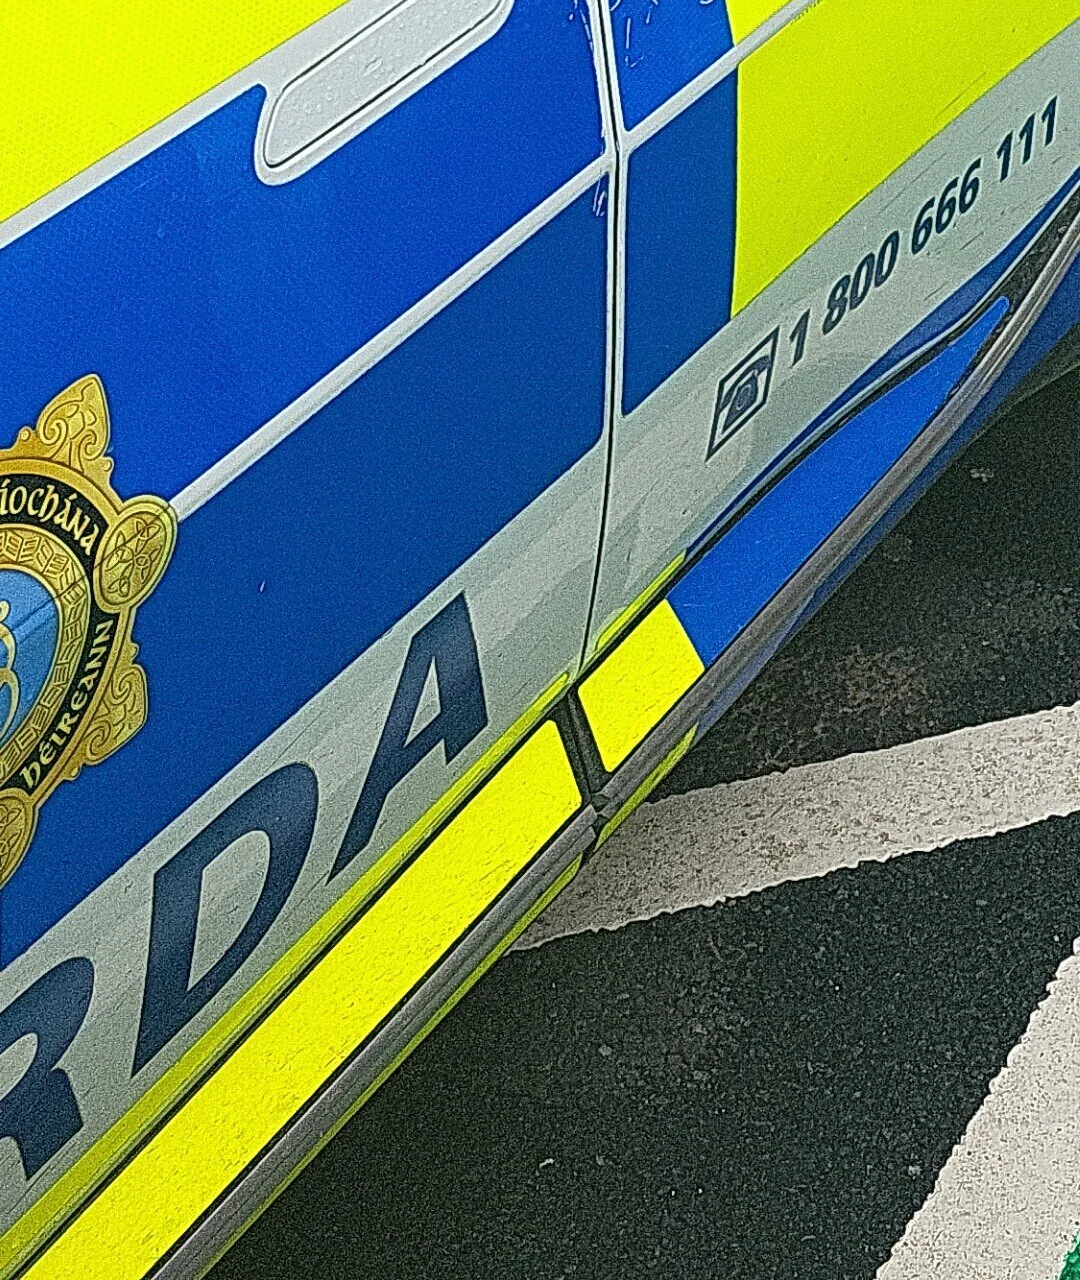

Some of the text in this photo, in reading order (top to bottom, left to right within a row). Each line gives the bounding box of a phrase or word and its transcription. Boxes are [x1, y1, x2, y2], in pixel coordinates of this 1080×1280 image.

[789, 95, 1058, 367] 1 800 666 111
[0, 478, 100, 556] íochána
[0, 590, 488, 1181] RDA
